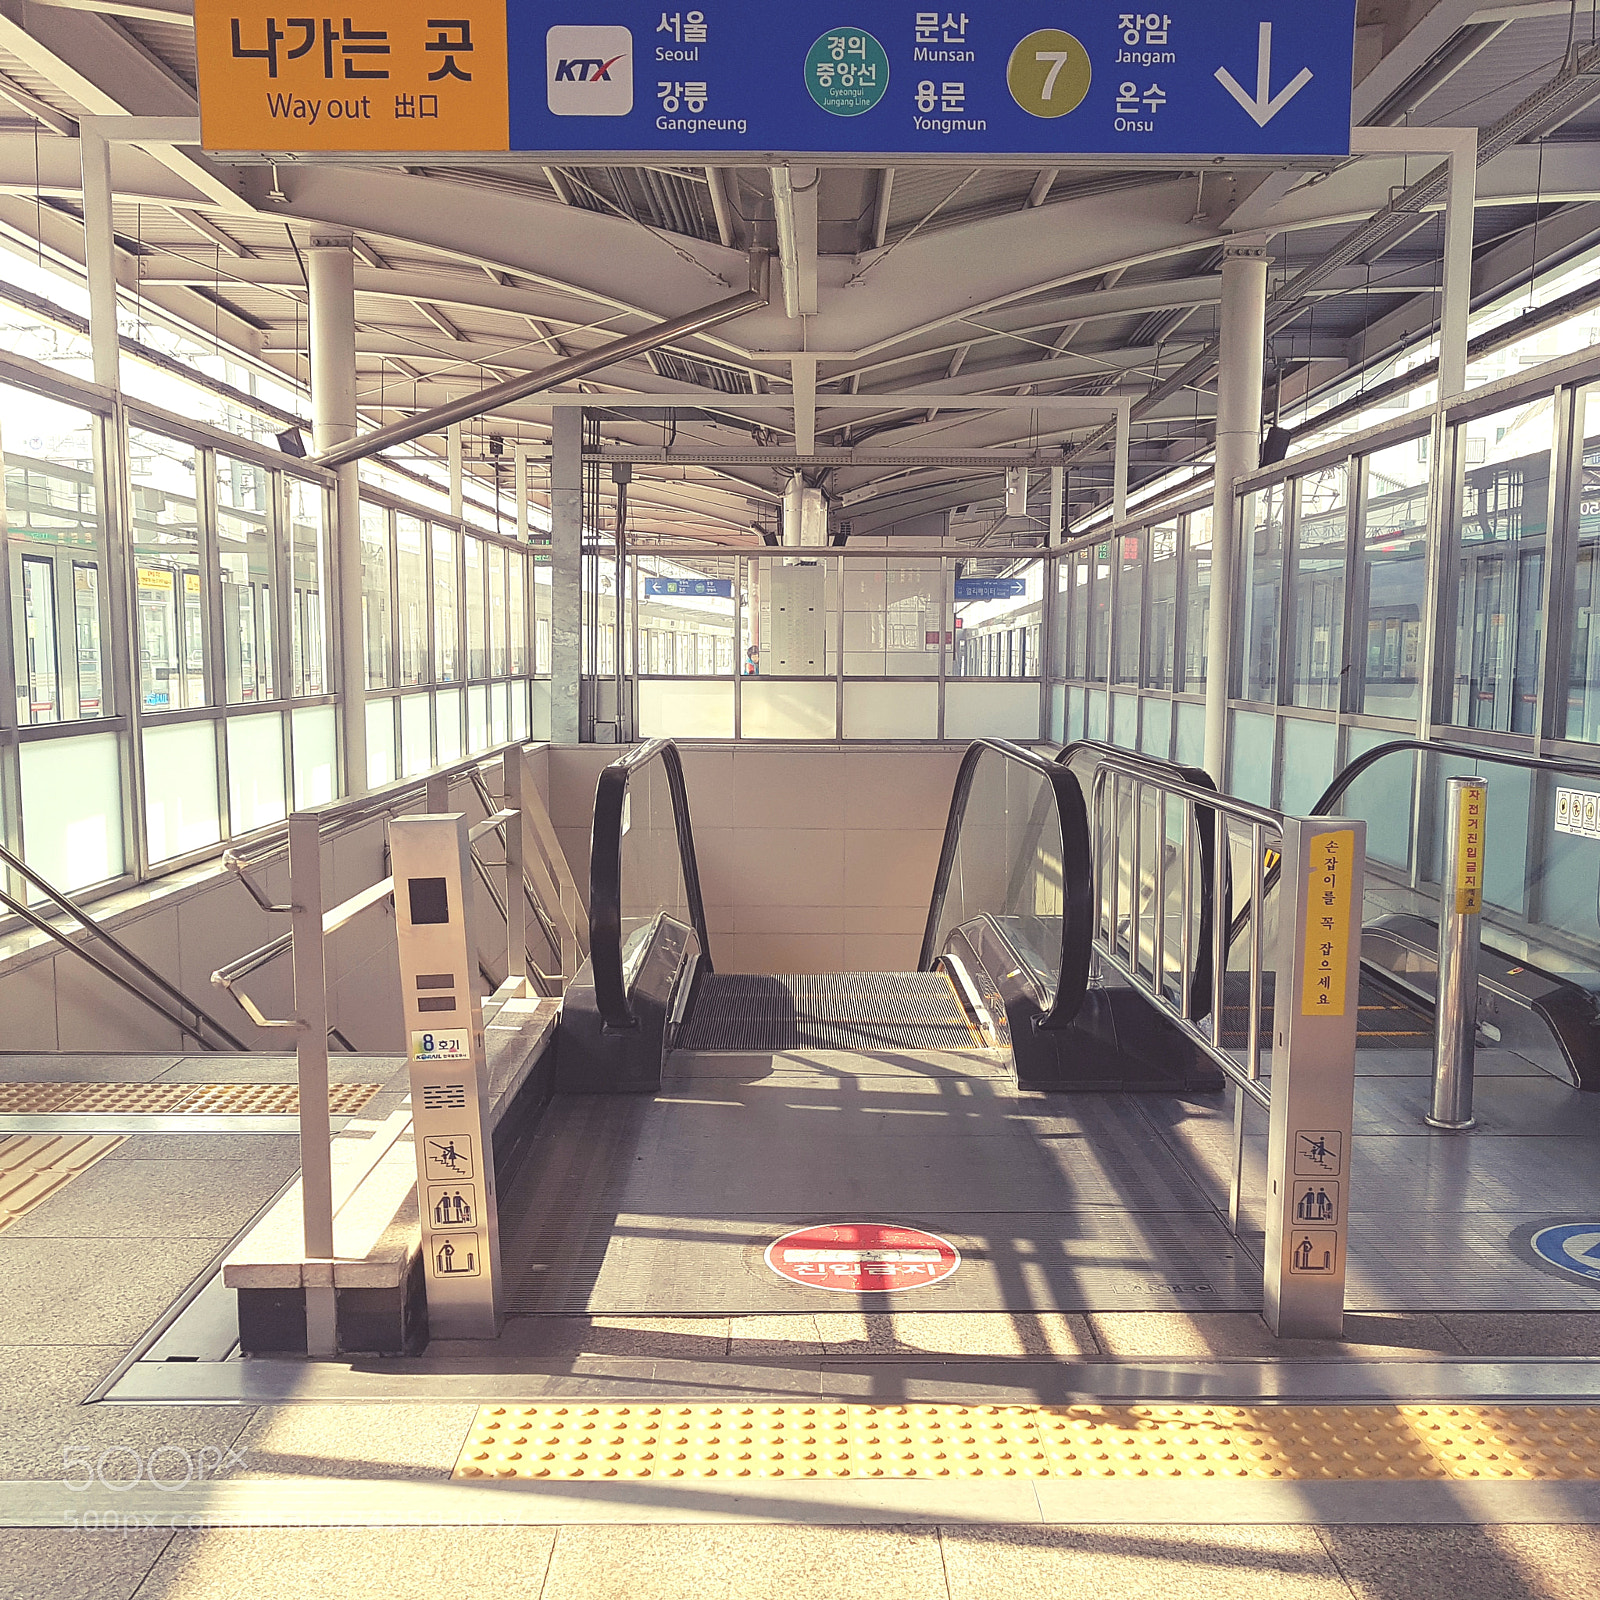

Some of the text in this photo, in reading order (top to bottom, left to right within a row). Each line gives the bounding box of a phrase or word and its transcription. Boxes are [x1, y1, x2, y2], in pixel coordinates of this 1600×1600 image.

[655, 10, 708, 43] 서울
[914, 12, 969, 44] 문산
[1117, 14, 1172, 45] 장암
[231, 18, 474, 82] 나가는 곳
[655, 46, 699, 61] Seoul
[827, 36, 866, 61] 경의
[914, 48, 974, 63] Munsan
[1115, 49, 1176, 67] Jangam
[554, 53, 627, 83] KTX
[816, 62, 876, 87] 중앙선
[1034, 51, 1069, 100] 7
[394, 93, 439, 119] 出口
[656, 81, 709, 113] 강릉
[823, 97, 871, 107] Jungang Line
[829, 88, 865, 98] Gyeongui
[914, 80, 966, 113] 용문
[1115, 82, 1167, 114] 온수
[267, 93, 370, 125] Way out
[655, 116, 747, 134] Gangneung
[913, 116, 987, 134] Yongmun
[1114, 117, 1154, 133] Onsu
[1464, 789, 1480, 888] 자전거진입금지
[1315, 839, 1340, 1006] 손잡이를 꼭 잡으세요
[423, 1034, 460, 1051] 8 호기
[793, 1262, 936, 1276] 진입금지
